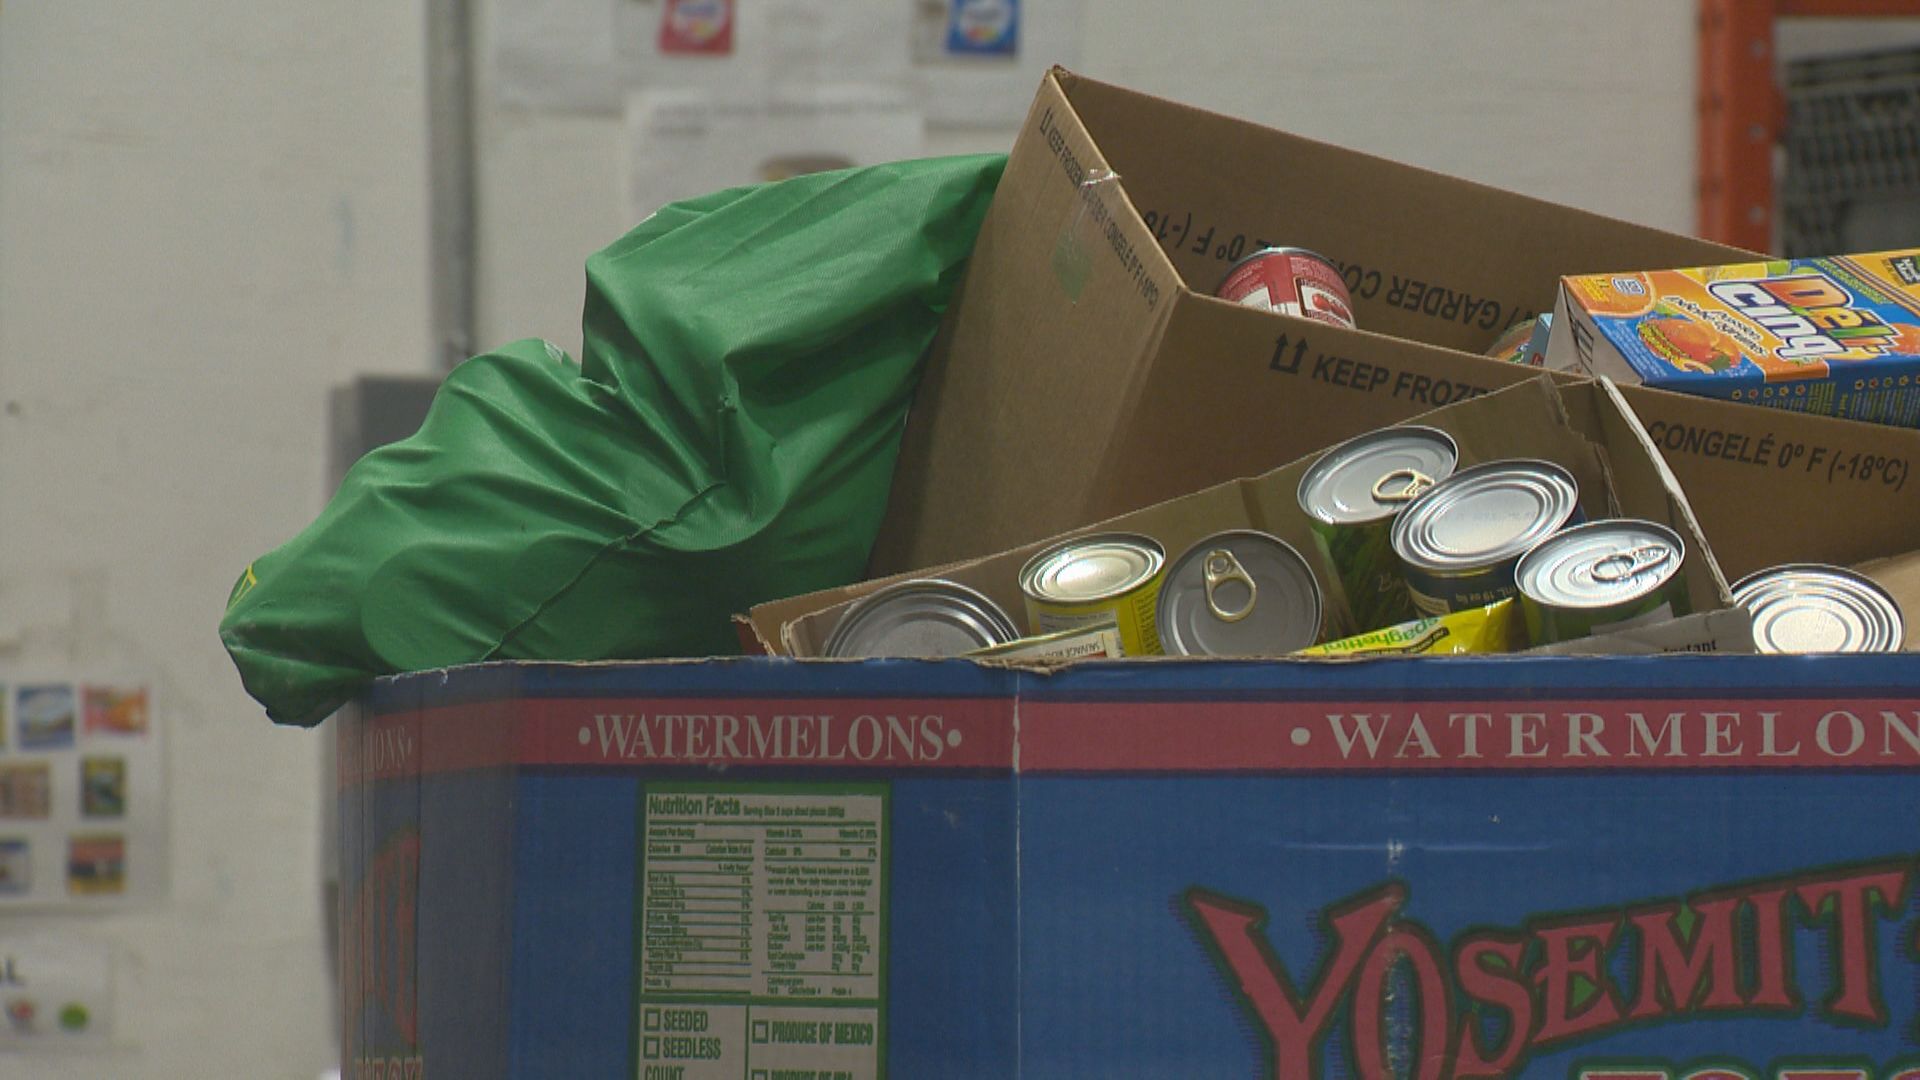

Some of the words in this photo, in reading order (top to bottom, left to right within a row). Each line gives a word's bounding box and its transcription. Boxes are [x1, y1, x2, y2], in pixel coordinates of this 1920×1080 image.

[1198, 227, 1215, 251] F
[1386, 282, 1499, 329] GARDER
[1312, 354, 1390, 392] KEEP
[1650, 421, 1774, 467] CONGELÉ
[1807, 448, 1826, 473] F
[595, 713, 943, 761] WATERMELONS
[648, 795, 702, 816] Nutrition
[706, 795, 741, 816] Facts
[663, 1010, 708, 1032] SEEDED
[772, 1021, 817, 1043] PRODUCE
[819, 1022, 833, 1044] OF
[835, 1022, 874, 1045] MEXICO
[663, 1037, 722, 1060] SEEDLESS
